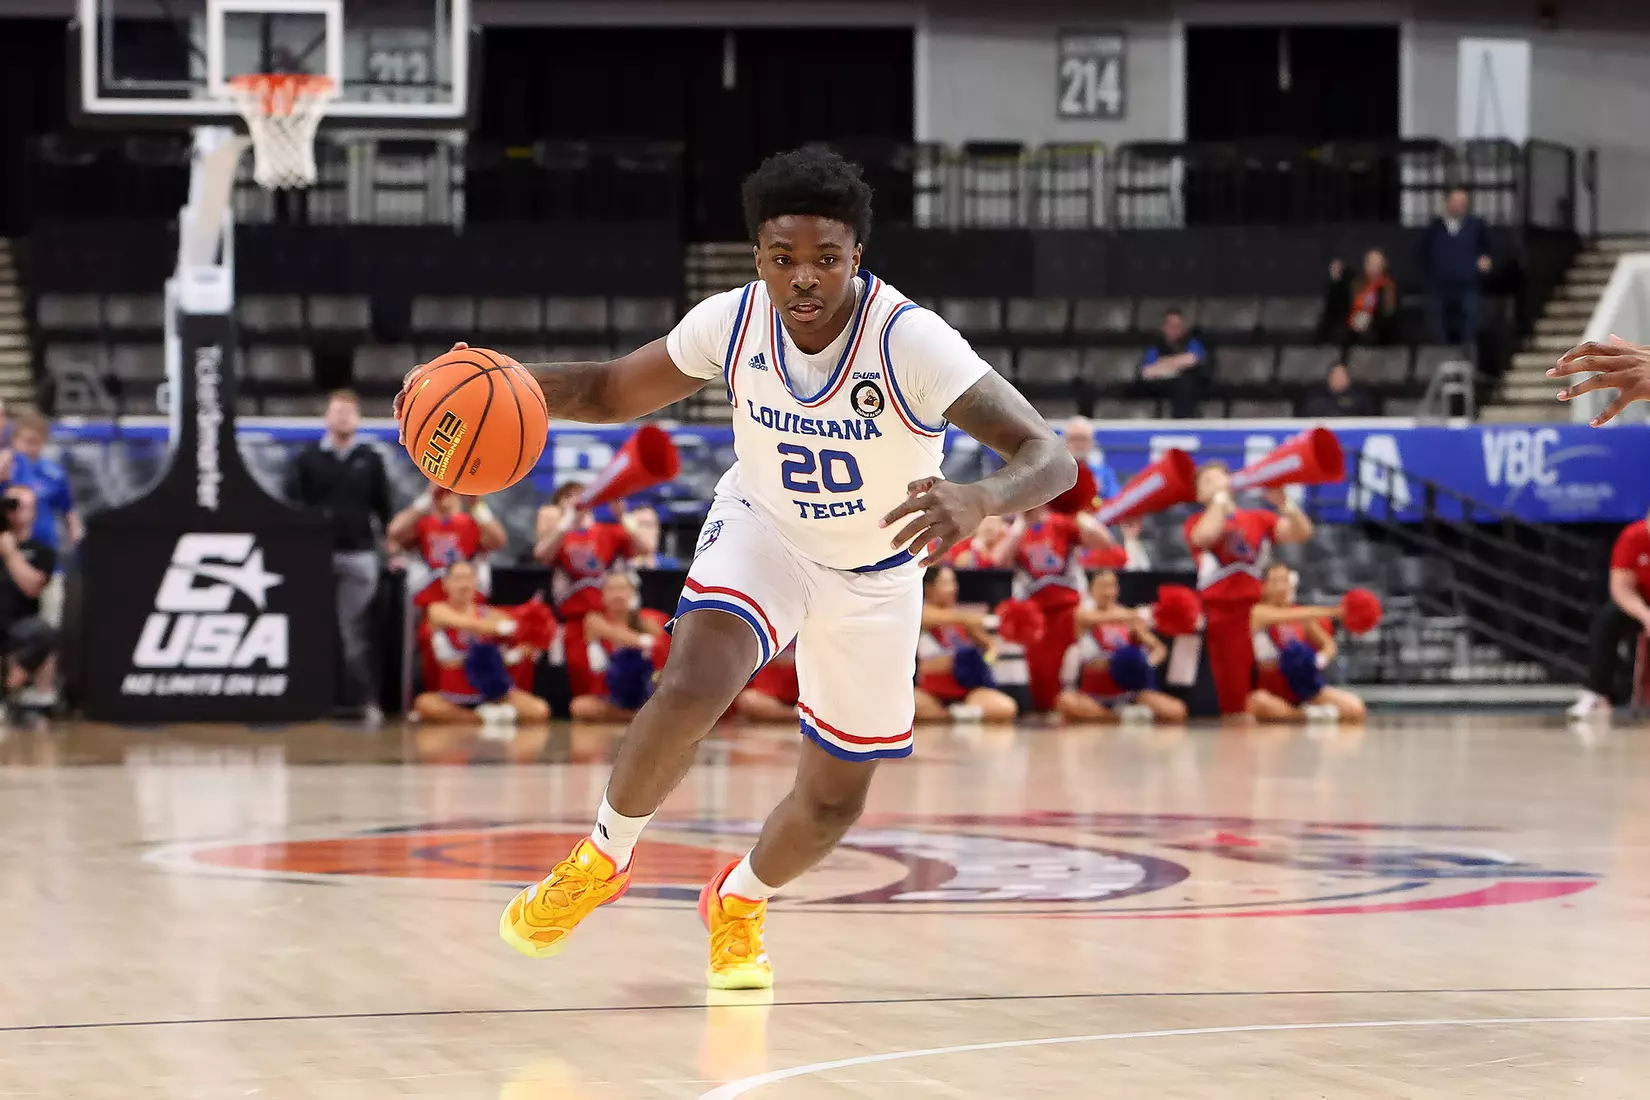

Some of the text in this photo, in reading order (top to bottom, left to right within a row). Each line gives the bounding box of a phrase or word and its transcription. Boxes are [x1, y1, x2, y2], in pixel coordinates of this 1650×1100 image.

[1060, 59, 1121, 113] 214
[748, 360, 768, 371] adidas
[421, 410, 463, 477] ELITE
[747, 399, 882, 440] LOUISIANA
[777, 442, 864, 494] 20
[1483, 428, 1559, 487] VBC
[793, 499, 866, 520] TECH
[132, 613, 288, 668] USA
